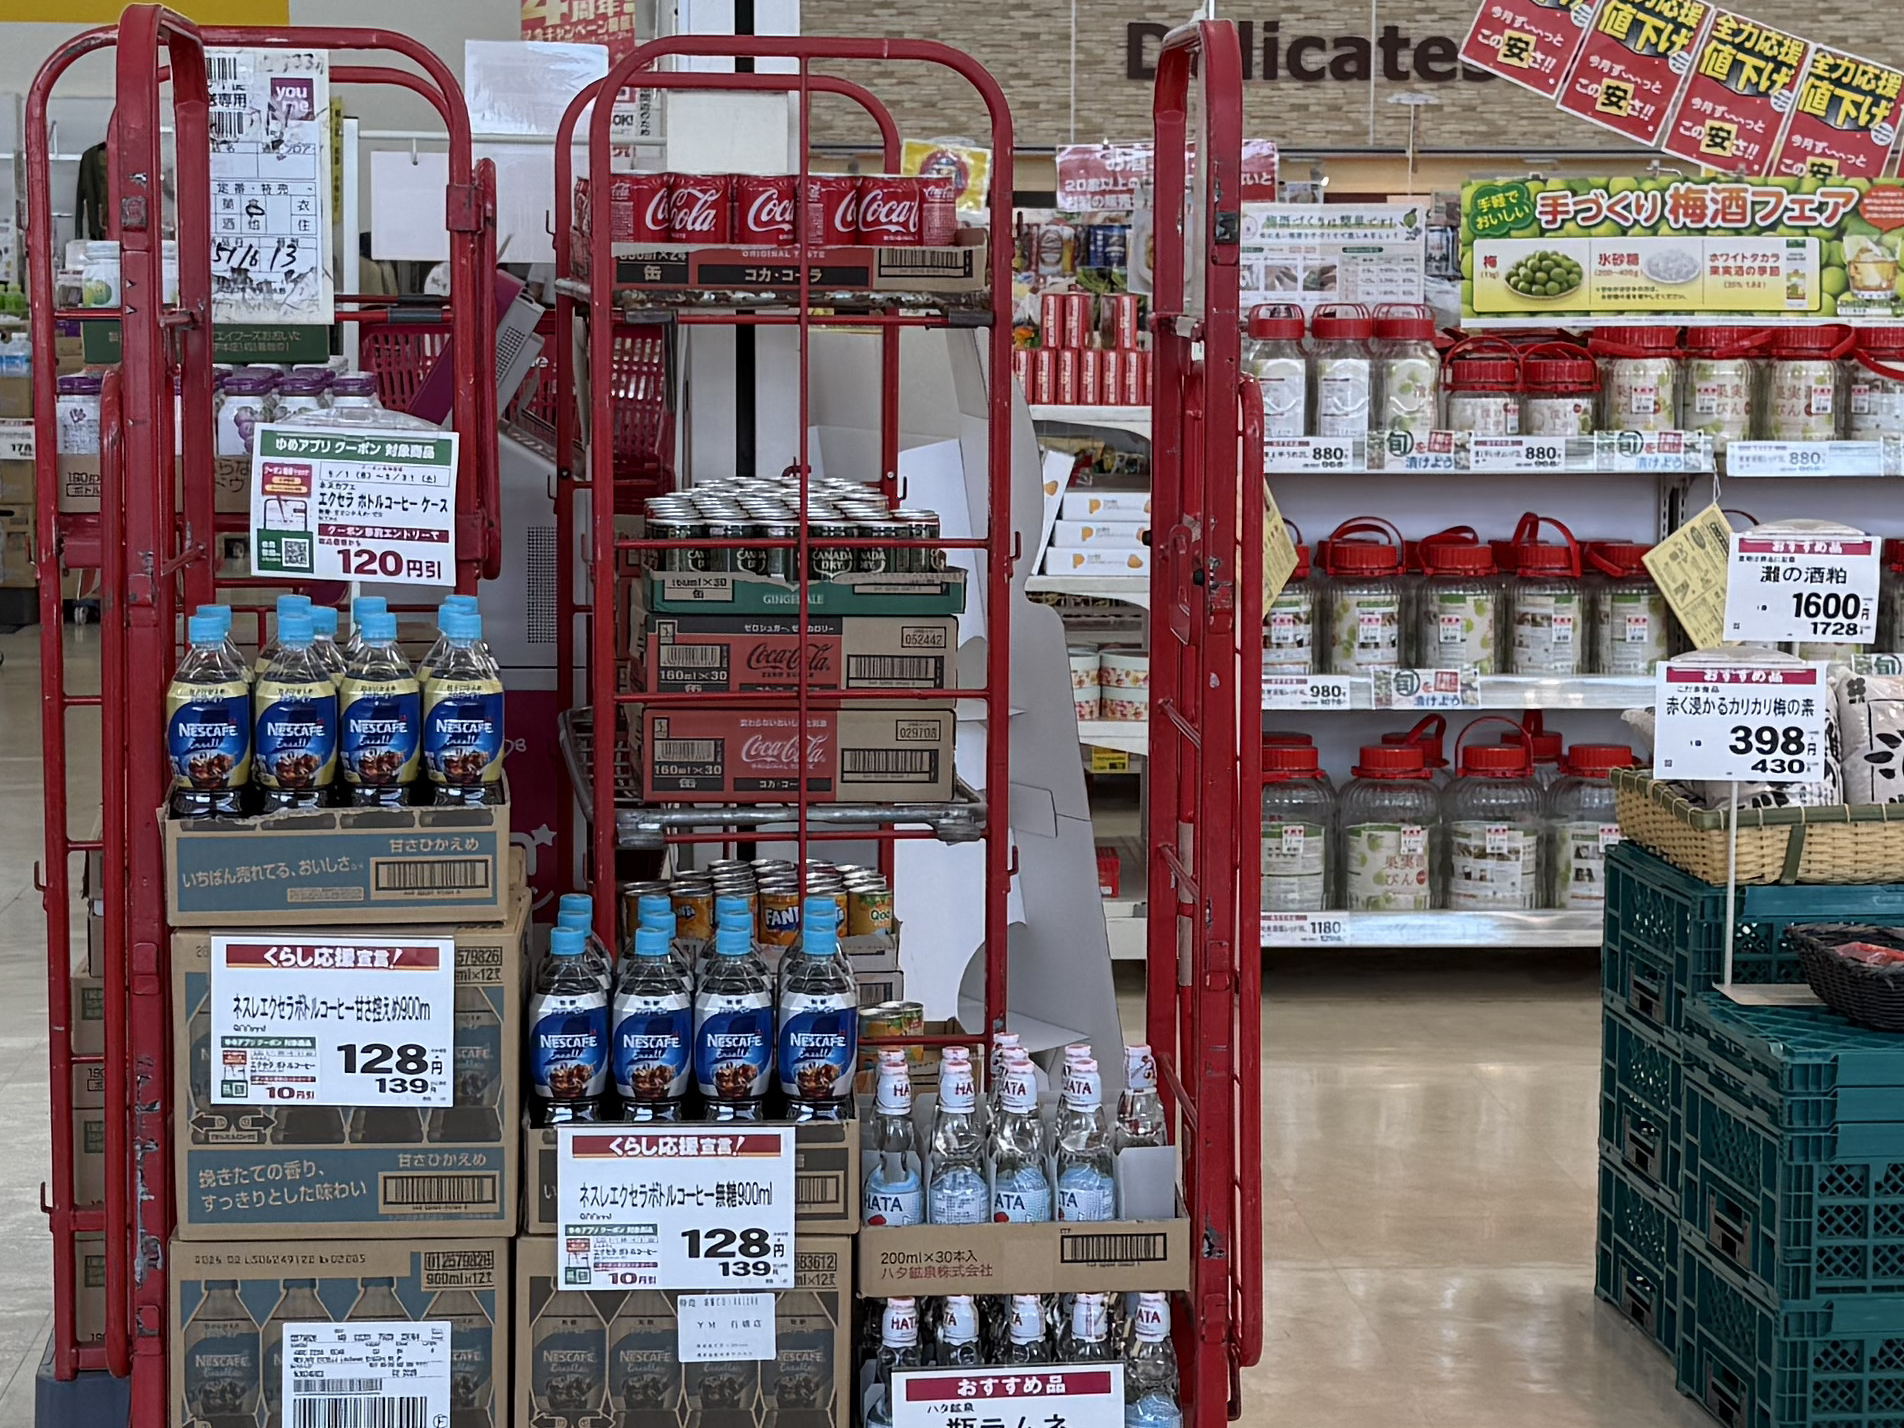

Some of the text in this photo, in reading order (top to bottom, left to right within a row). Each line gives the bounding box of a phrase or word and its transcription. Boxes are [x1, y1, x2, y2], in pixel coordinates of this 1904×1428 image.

[1713, 13, 1806, 66] 全力応援
[1809, 51, 1903, 100] 全力応援
[276, 84, 307, 100] you
[1475, 204, 1530, 229] おいしい
[1598, 254, 1641, 267] 氷砂糖
[276, 439, 331, 451] ゆめアプリ
[335, 442, 381, 454] クーポン
[319, 492, 354, 506] エクセラ
[422, 499, 447, 513] ケース
[1792, 592, 1862, 619] 1600
[1811, 622, 1858, 636] 1728
[1729, 725, 1806, 756] 398
[1751, 759, 1806, 774] 430
[337, 1043, 430, 1076] 128
[375, 1078, 429, 1094] 139
[680, 1228, 771, 1259] 128
[719, 1261, 772, 1278] 139
[956, 1376, 1067, 1397] おすすめ品
